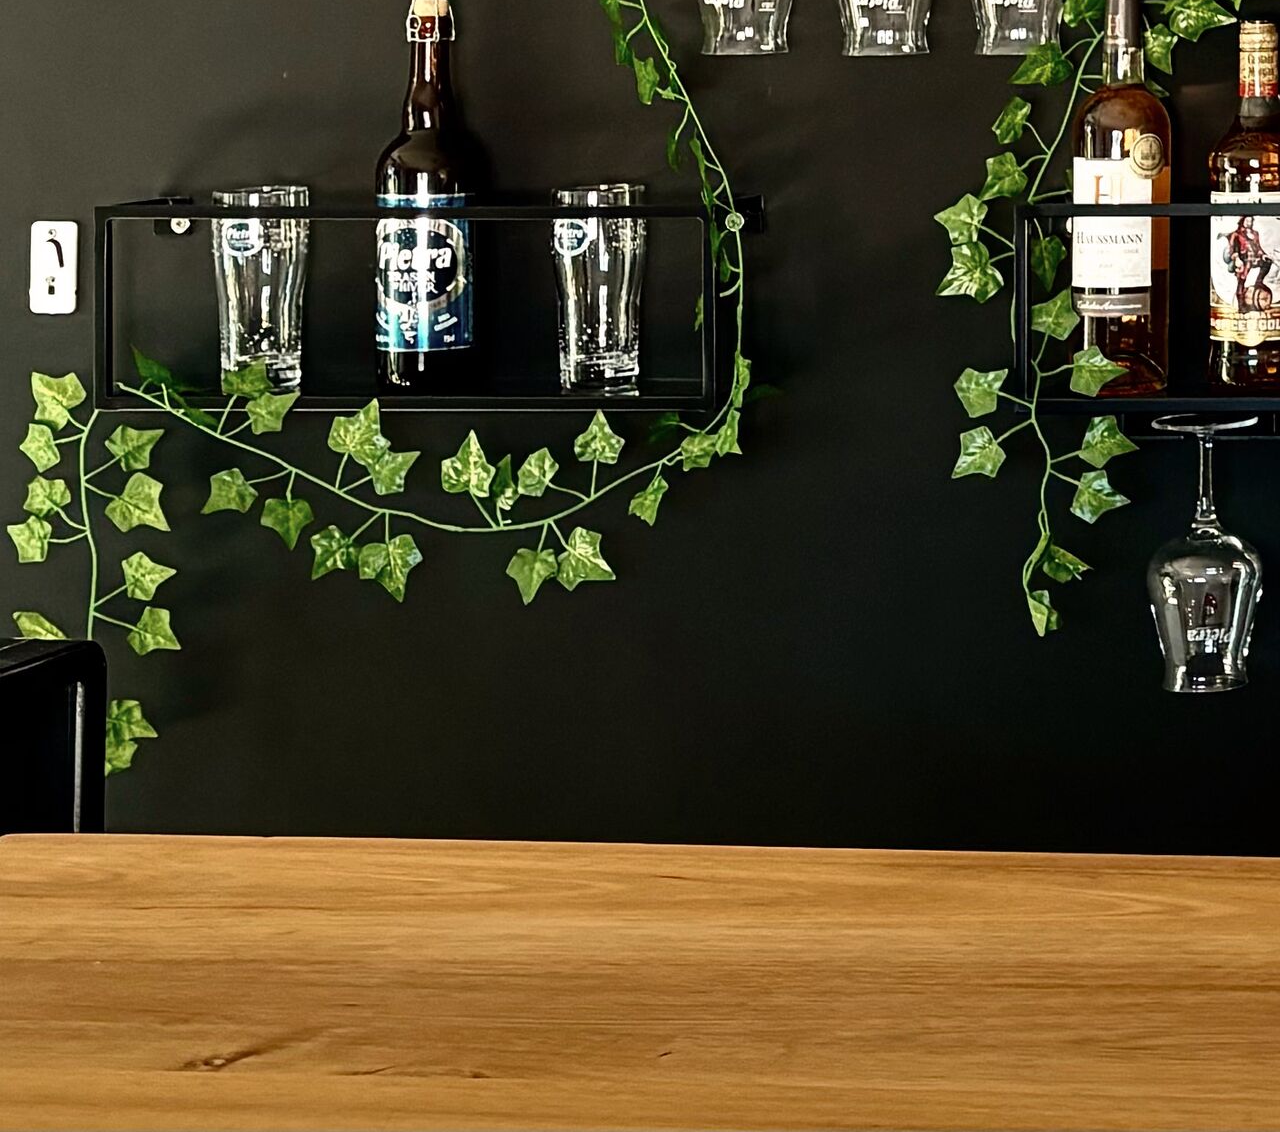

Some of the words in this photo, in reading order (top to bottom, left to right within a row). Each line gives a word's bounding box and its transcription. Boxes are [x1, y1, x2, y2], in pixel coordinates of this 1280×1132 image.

[1076, 231, 1144, 245] HAUSSMANN
[379, 240, 453, 271] Pietra
[1187, 627, 1232, 645] Pietra
